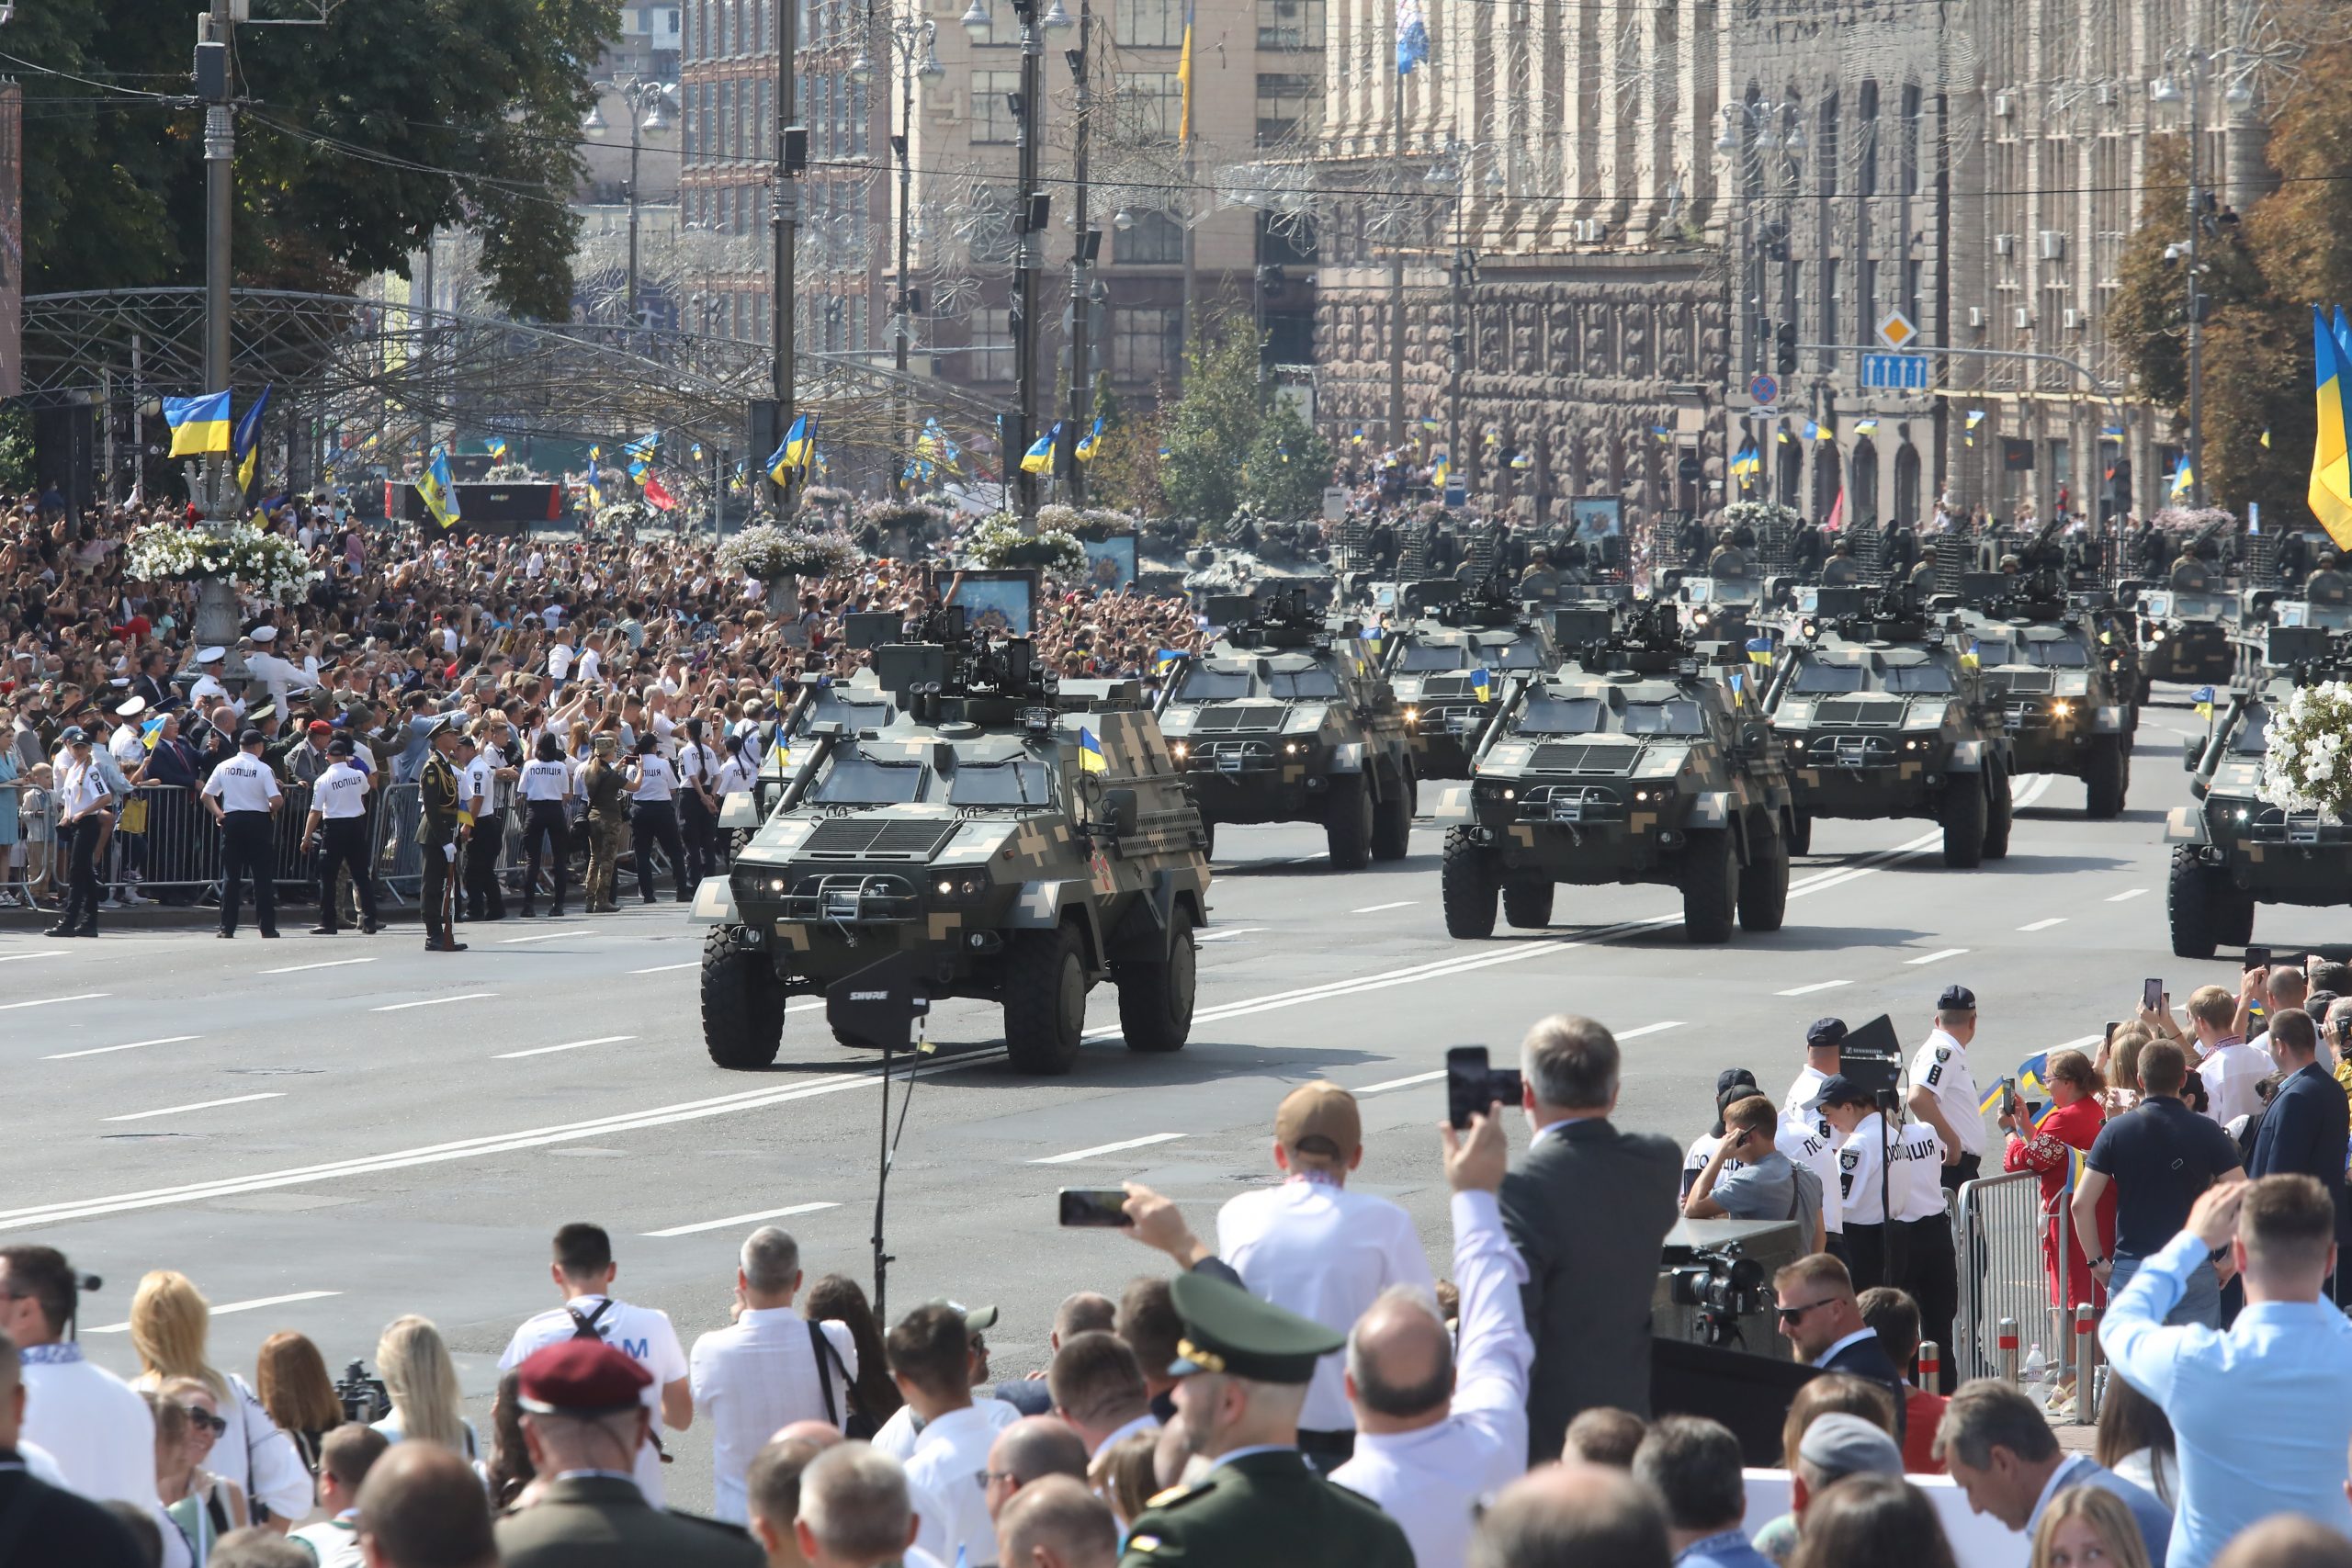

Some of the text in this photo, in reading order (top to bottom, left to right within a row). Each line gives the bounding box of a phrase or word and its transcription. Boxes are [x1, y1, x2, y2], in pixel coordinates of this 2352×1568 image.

[224, 767, 257, 779] ПОЛІЦІЯ
[530, 767, 561, 777] ПОЛІЦІЯ
[632, 769, 662, 778] ПЛІЦІЯ
[332, 776, 362, 791] ПОЛІЦІЯ
[850, 991, 888, 1000] SHURE
